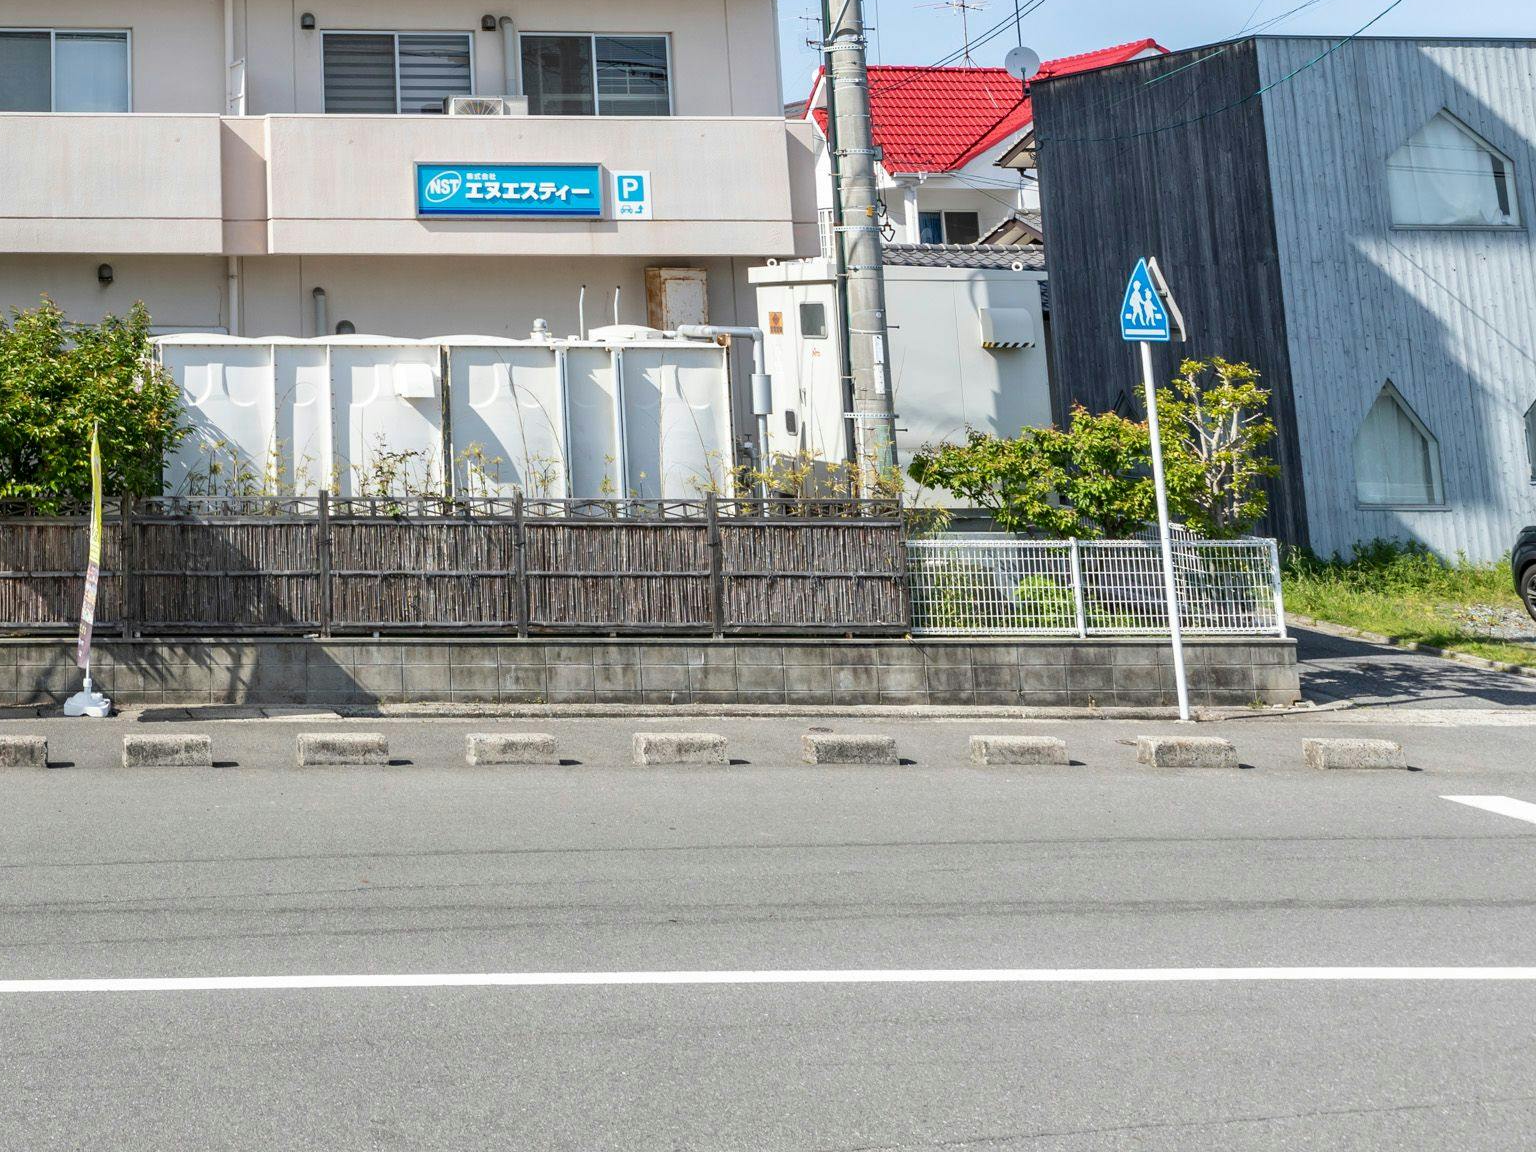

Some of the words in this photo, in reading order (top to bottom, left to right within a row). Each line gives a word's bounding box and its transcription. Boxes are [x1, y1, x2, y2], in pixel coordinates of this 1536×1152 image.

[466, 173, 497, 181] 株式会社
[429, 178, 461, 195] NST
[465, 181, 591, 200] エヌエスティー
[621, 177, 639, 199] P
